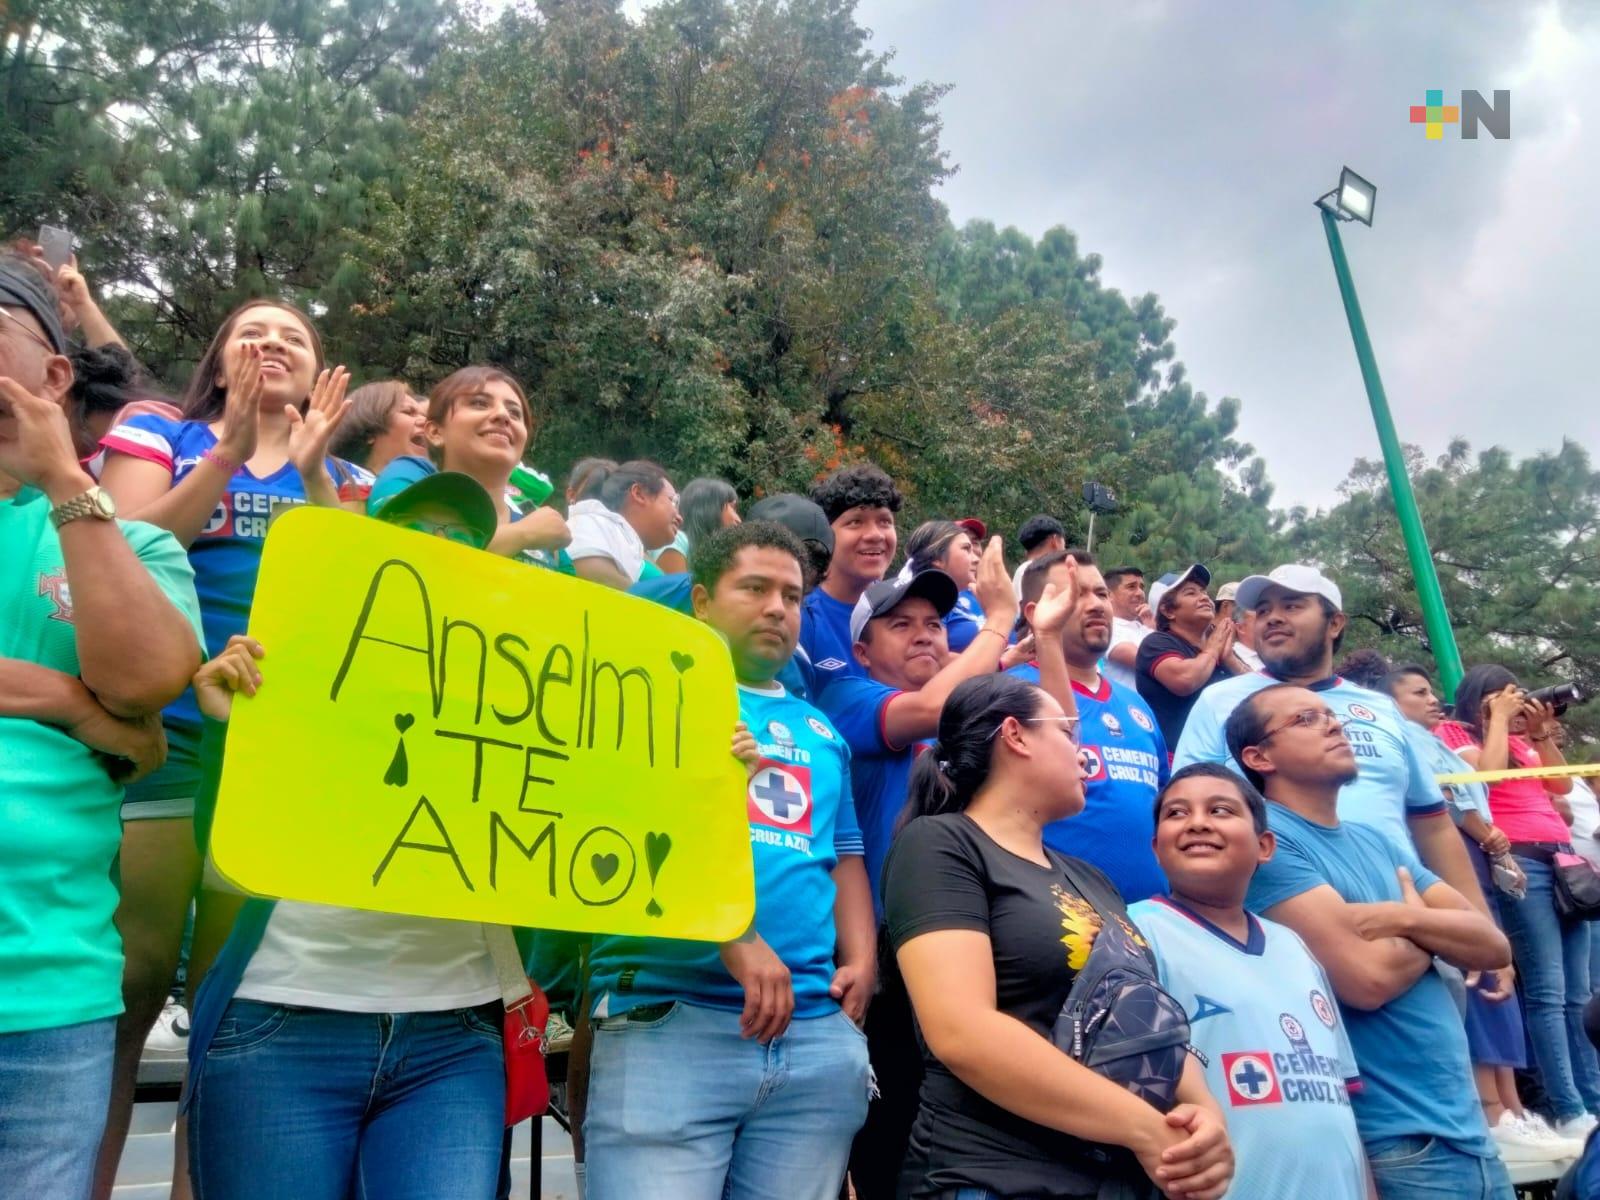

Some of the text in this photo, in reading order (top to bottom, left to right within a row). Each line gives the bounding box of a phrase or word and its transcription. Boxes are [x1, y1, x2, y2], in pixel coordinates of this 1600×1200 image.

[235, 516, 267, 538] CR
[330, 558, 694, 768] Anselmi
[1352, 744, 1382, 758] ZUL
[1107, 764, 1143, 782] CRUZ
[750, 828, 783, 847] CRUZ
[1282, 1078, 1335, 1104] CRUZ
